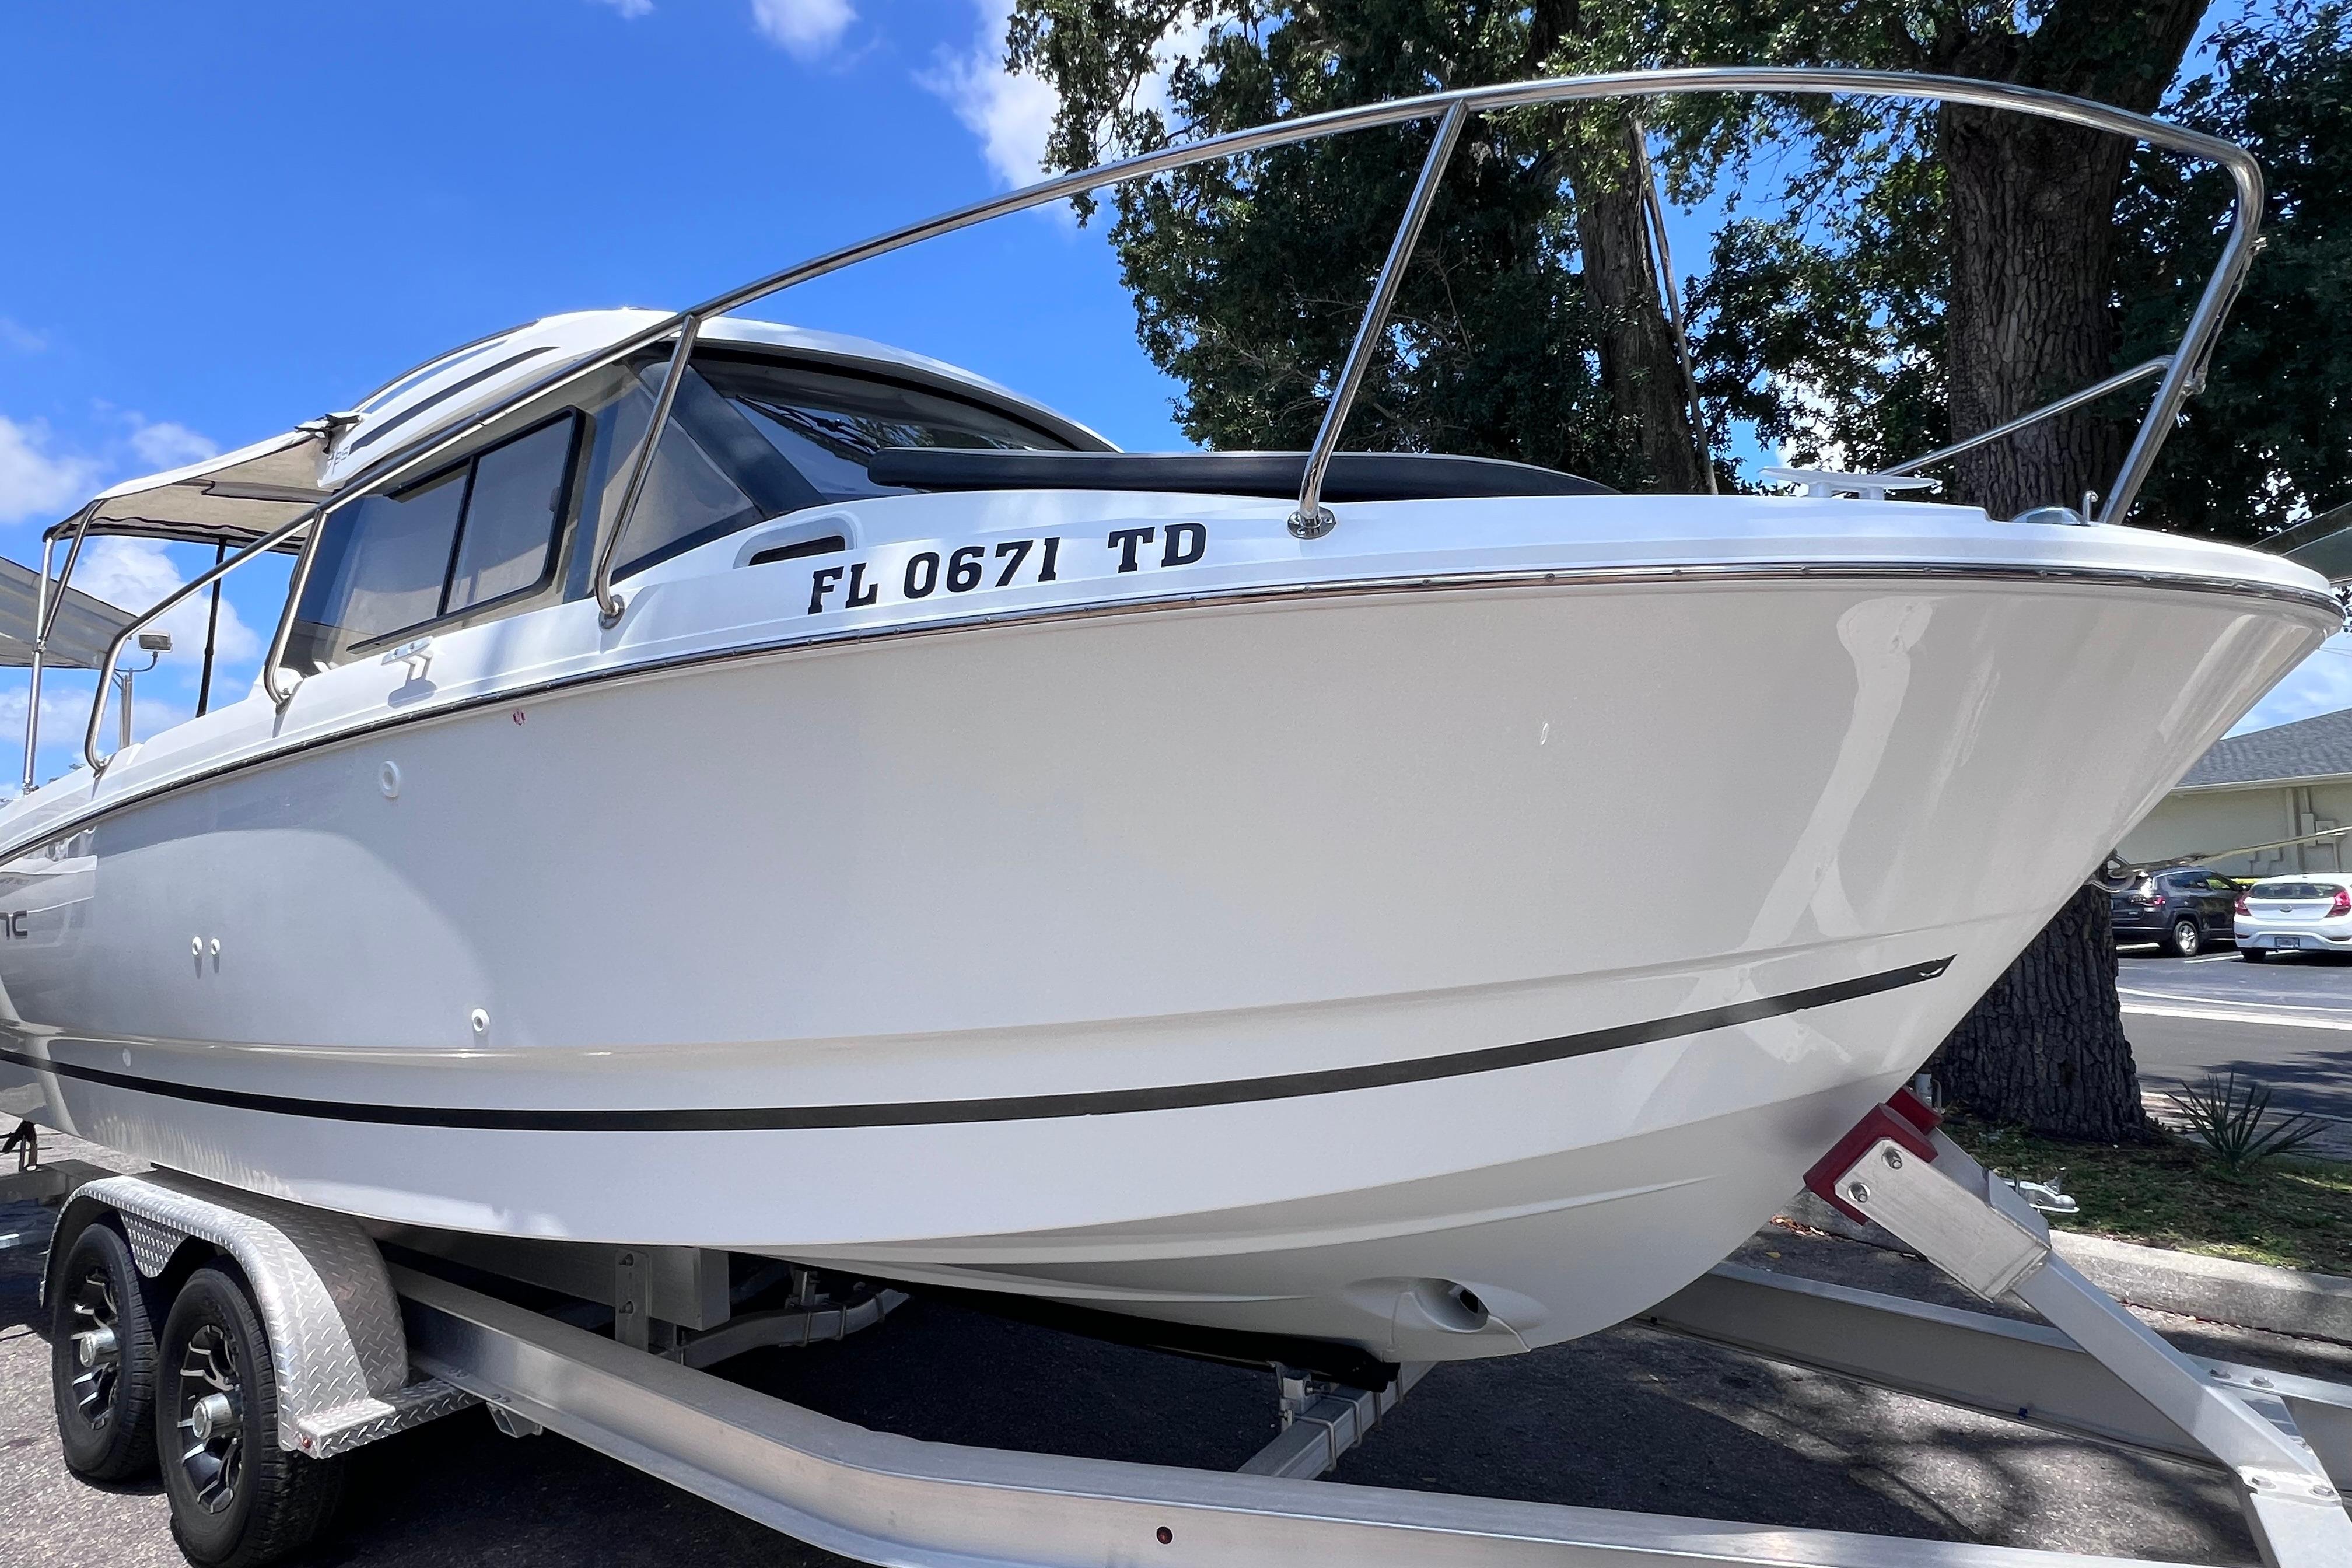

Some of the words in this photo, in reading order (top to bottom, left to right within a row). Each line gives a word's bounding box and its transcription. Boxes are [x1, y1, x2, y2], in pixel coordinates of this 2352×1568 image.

[807, 562, 878, 615] FL
[903, 537, 1060, 598] 0671
[1107, 523, 1206, 574] TD
